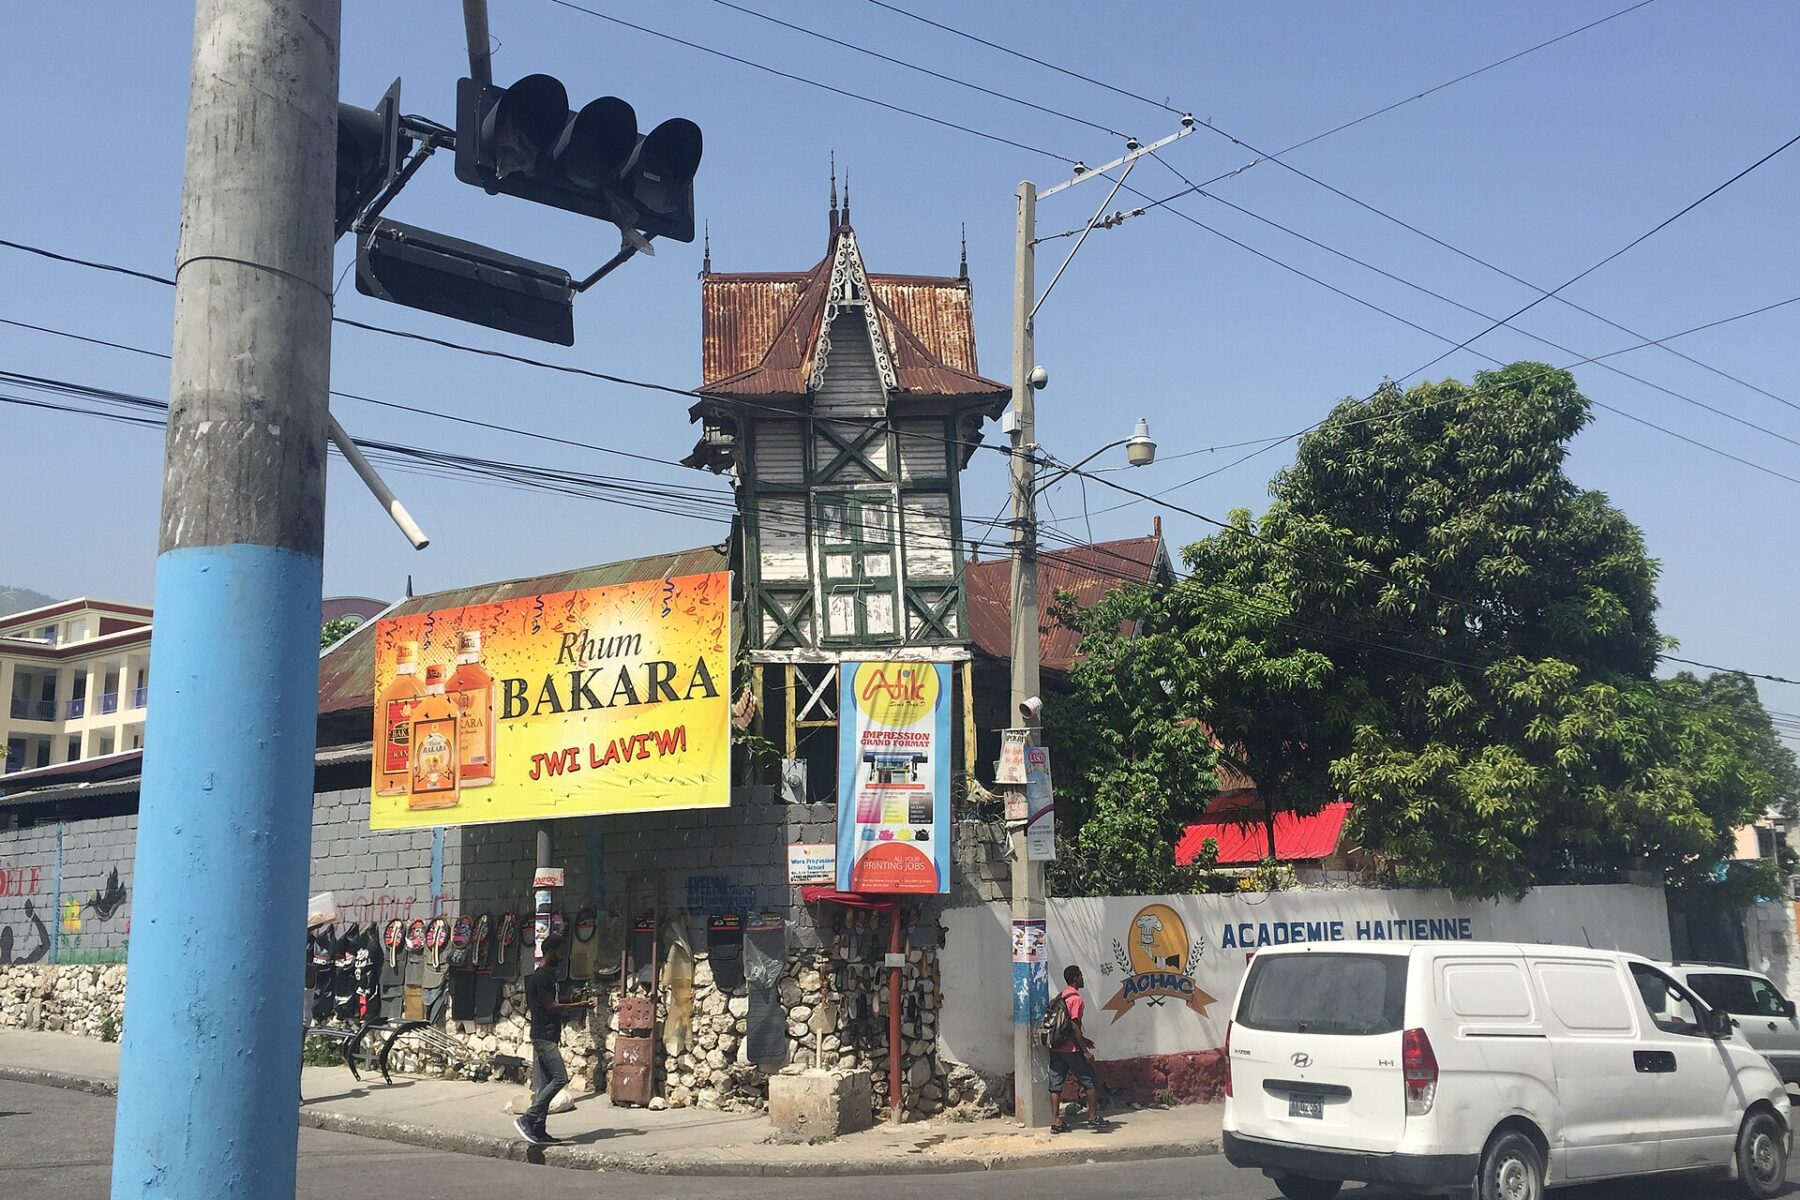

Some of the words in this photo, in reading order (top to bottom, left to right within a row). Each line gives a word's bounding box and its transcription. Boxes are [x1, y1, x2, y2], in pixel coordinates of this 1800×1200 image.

[556, 628, 642, 665] Rhum
[499, 655, 720, 719] BAKARA
[862, 668, 925, 701] Atik
[860, 738, 891, 746] GRAND
[892, 739, 930, 747] FORMAT
[862, 730, 930, 741] IMPRESSION
[529, 748, 580, 780] JWI
[589, 724, 687, 768] LAVI'W!
[863, 861, 903, 870] PRINTING
[904, 861, 926, 872] JOBS
[1222, 921, 1344, 949] ACADEMIE
[1356, 918, 1472, 941] HAITIENNE
[1123, 973, 1194, 999] ACHAC
